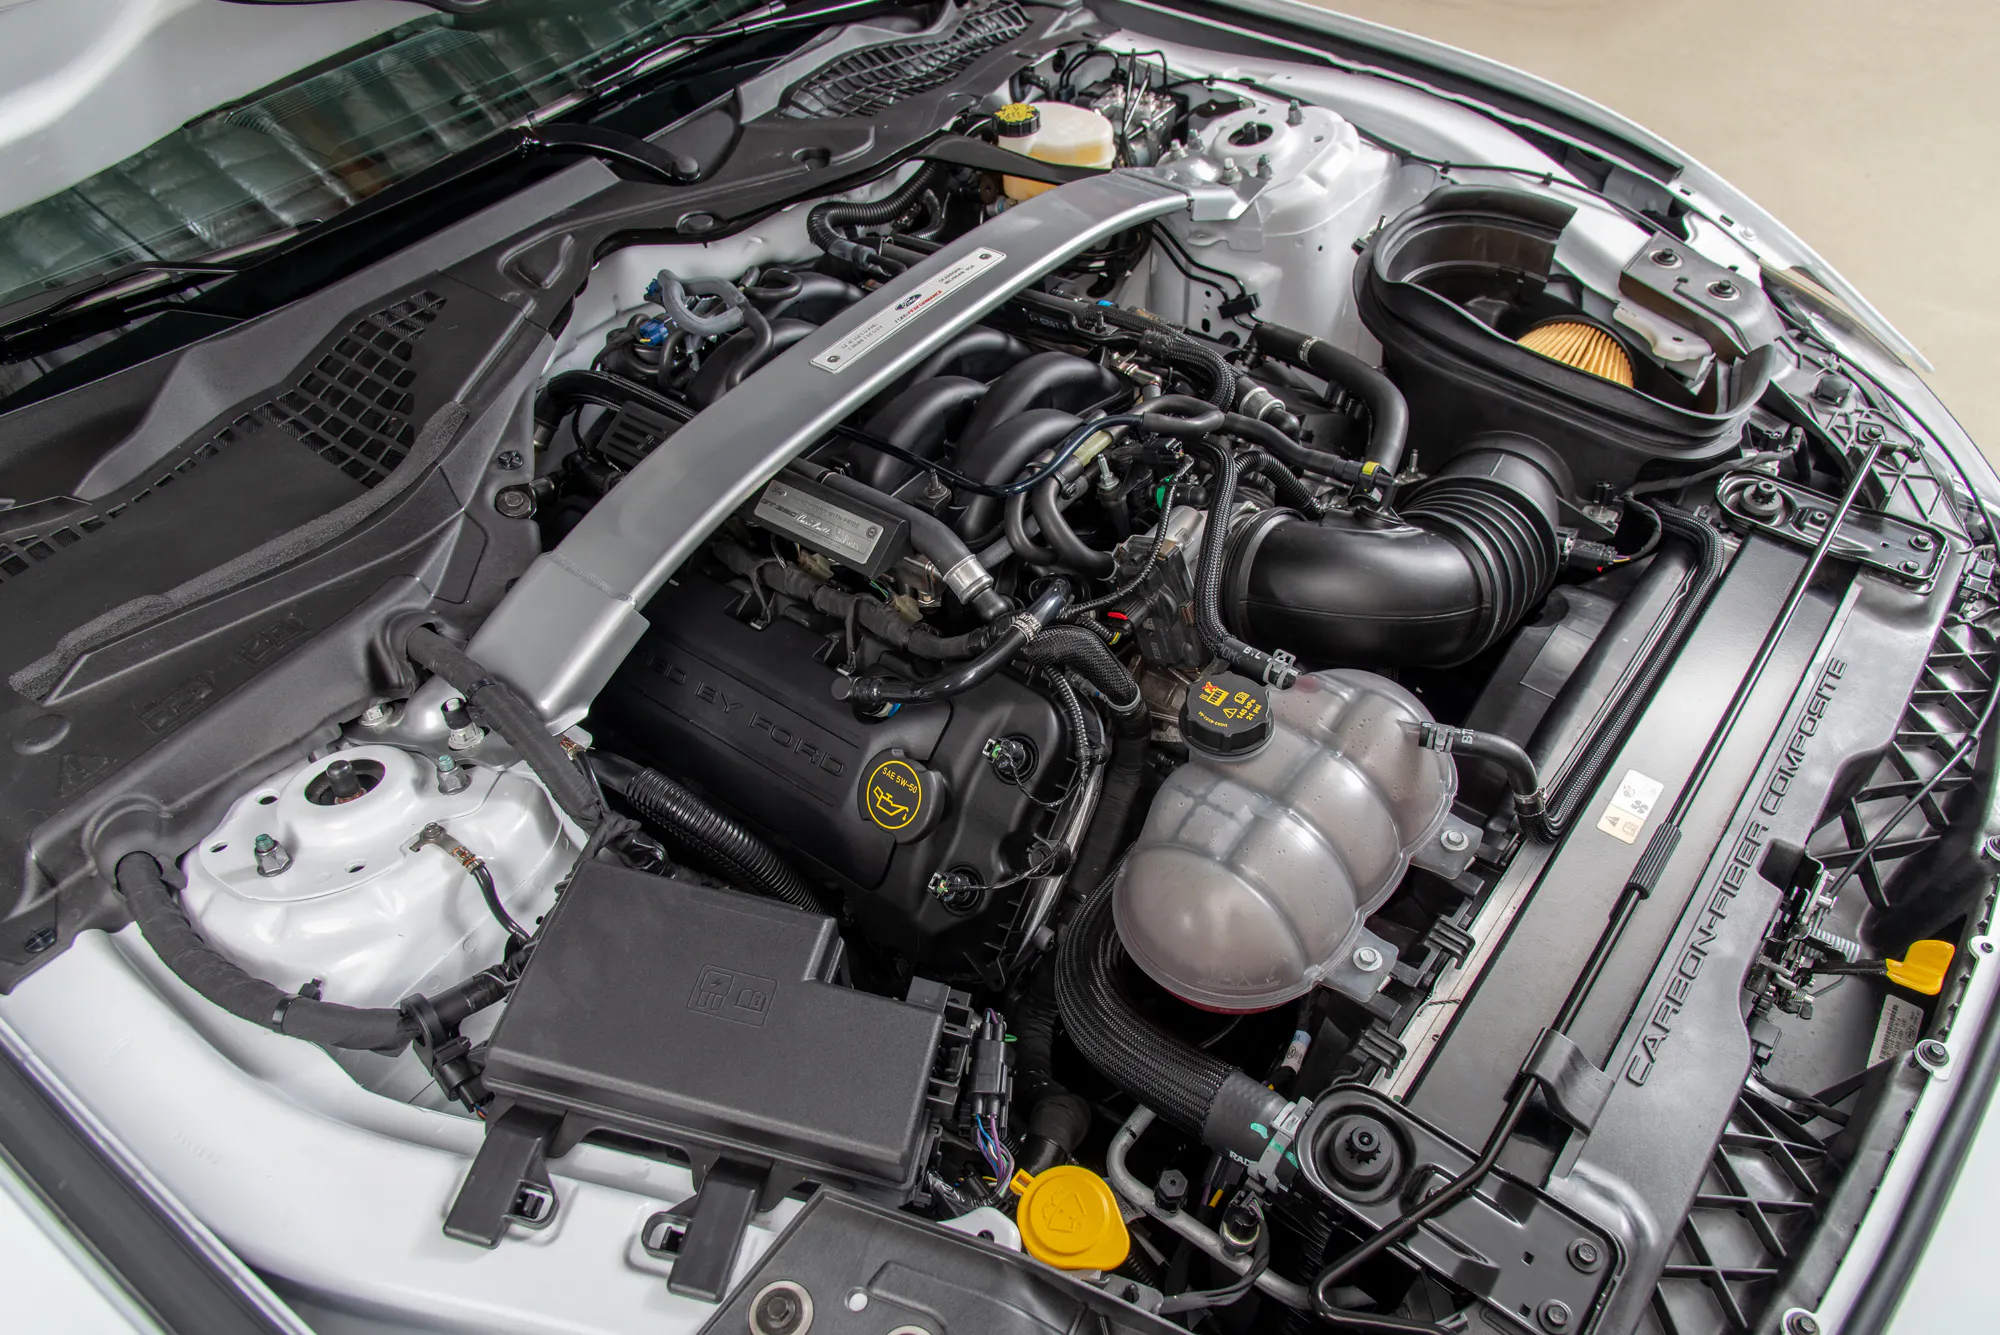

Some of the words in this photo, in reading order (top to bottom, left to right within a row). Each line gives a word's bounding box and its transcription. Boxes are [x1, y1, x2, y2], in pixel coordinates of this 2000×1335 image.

[695, 680, 744, 713] BY
[749, 711, 845, 777] FORD
[882, 767, 896, 780] SAE
[896, 775, 917, 793] 5W-50
[1626, 820, 1770, 1087] CARBON-FIBER
[1760, 657, 1847, 816] COMPOSITE
